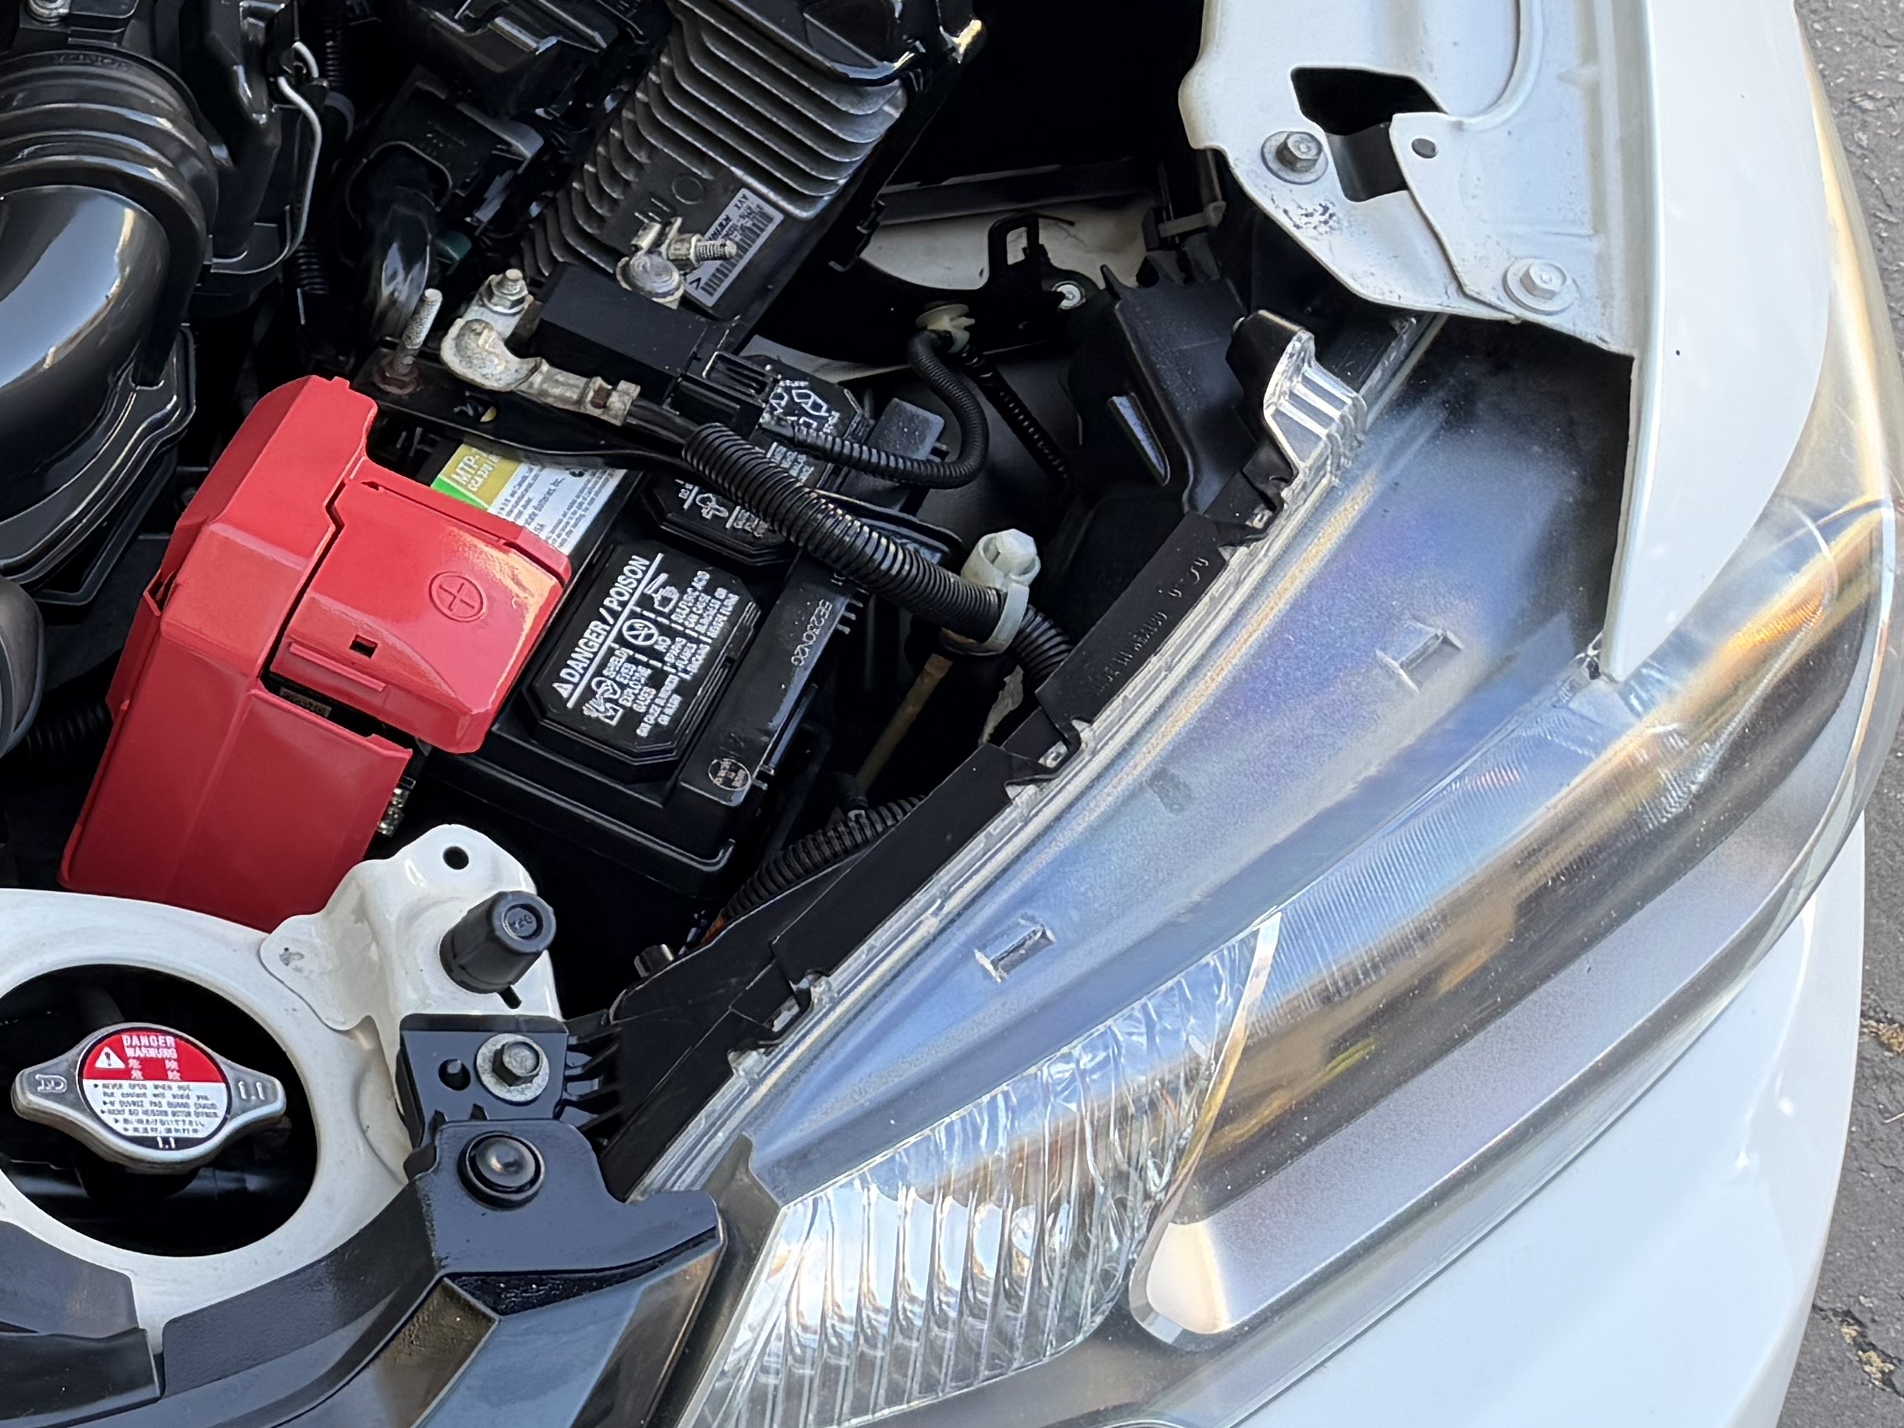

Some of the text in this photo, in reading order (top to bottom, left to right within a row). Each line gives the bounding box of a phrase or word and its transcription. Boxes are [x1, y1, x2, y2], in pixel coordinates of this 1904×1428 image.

[559, 620, 611, 684] DANGER
[603, 555, 651, 611] POISON
[121, 1033, 177, 1048] DANGER
[155, 1136, 177, 1150] 1.1
